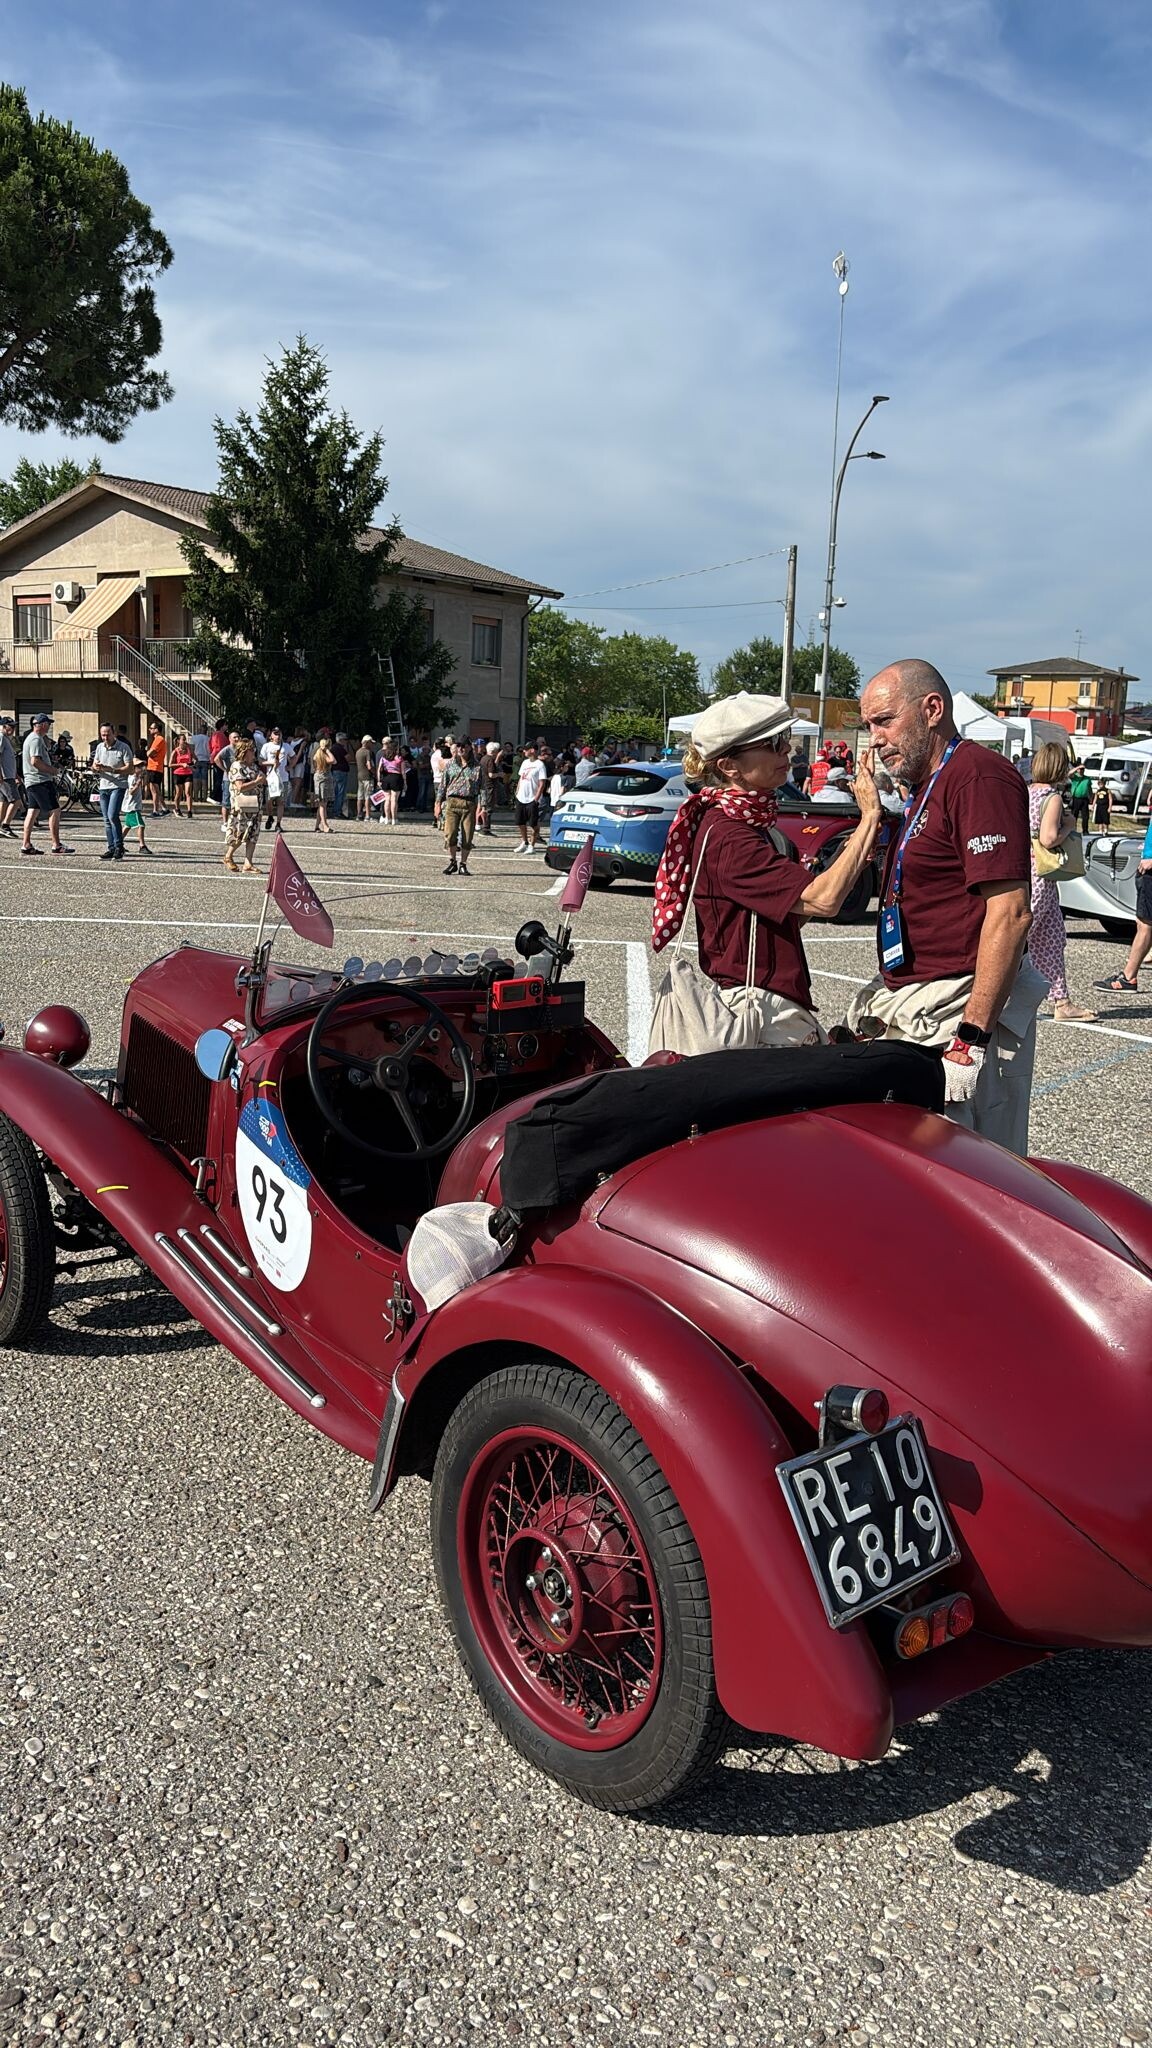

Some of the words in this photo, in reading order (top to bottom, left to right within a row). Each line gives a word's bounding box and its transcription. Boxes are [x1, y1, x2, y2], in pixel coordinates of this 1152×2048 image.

[562, 815, 599, 826] POLIZIA
[801, 825, 820, 834] 64
[981, 834, 1007, 845] Miglia
[972, 842, 994, 855] 2025
[252, 1165, 288, 1244] 93
[793, 1451, 872, 1538] RE
[867, 1428, 925, 1502] 10
[828, 1495, 943, 1605] 6849
